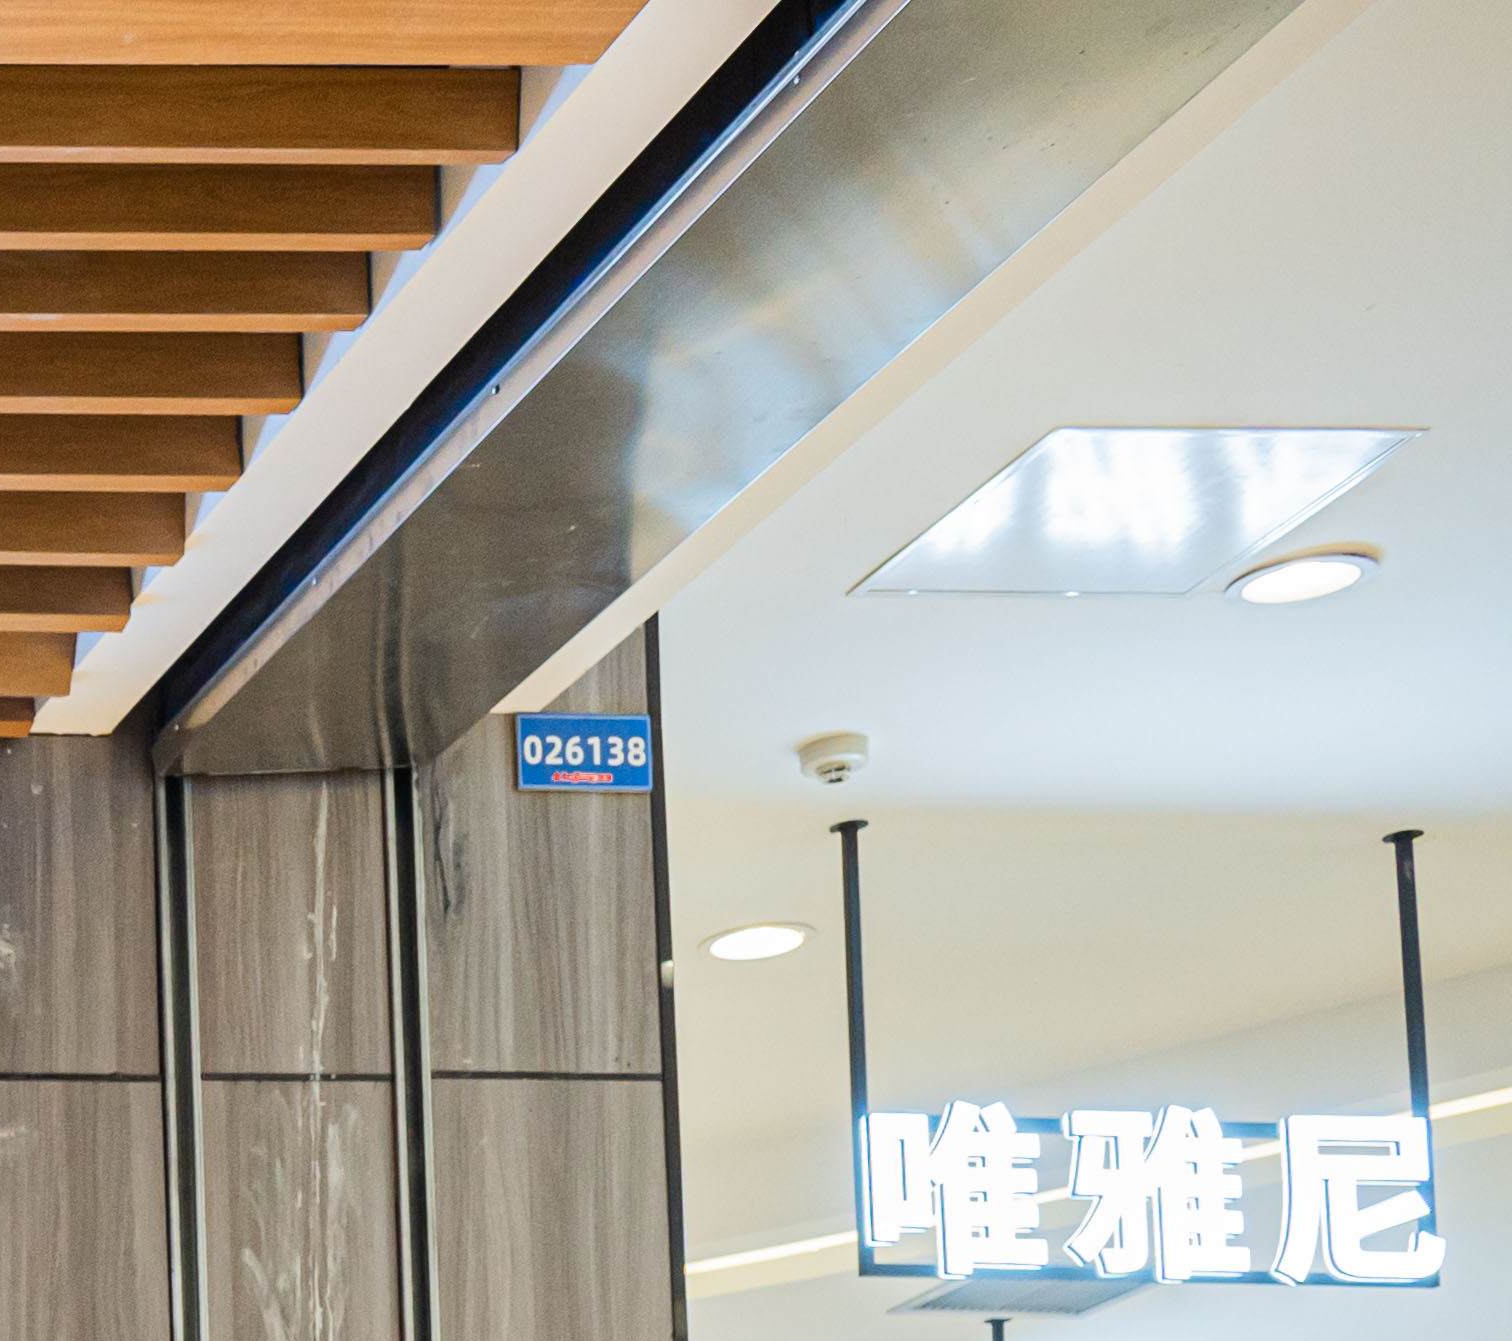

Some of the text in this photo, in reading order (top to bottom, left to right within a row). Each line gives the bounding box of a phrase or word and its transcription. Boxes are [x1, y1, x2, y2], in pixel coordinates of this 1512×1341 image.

[523, 735, 647, 767] 026138
[860, 1100, 1446, 1286] 唯雅尼
